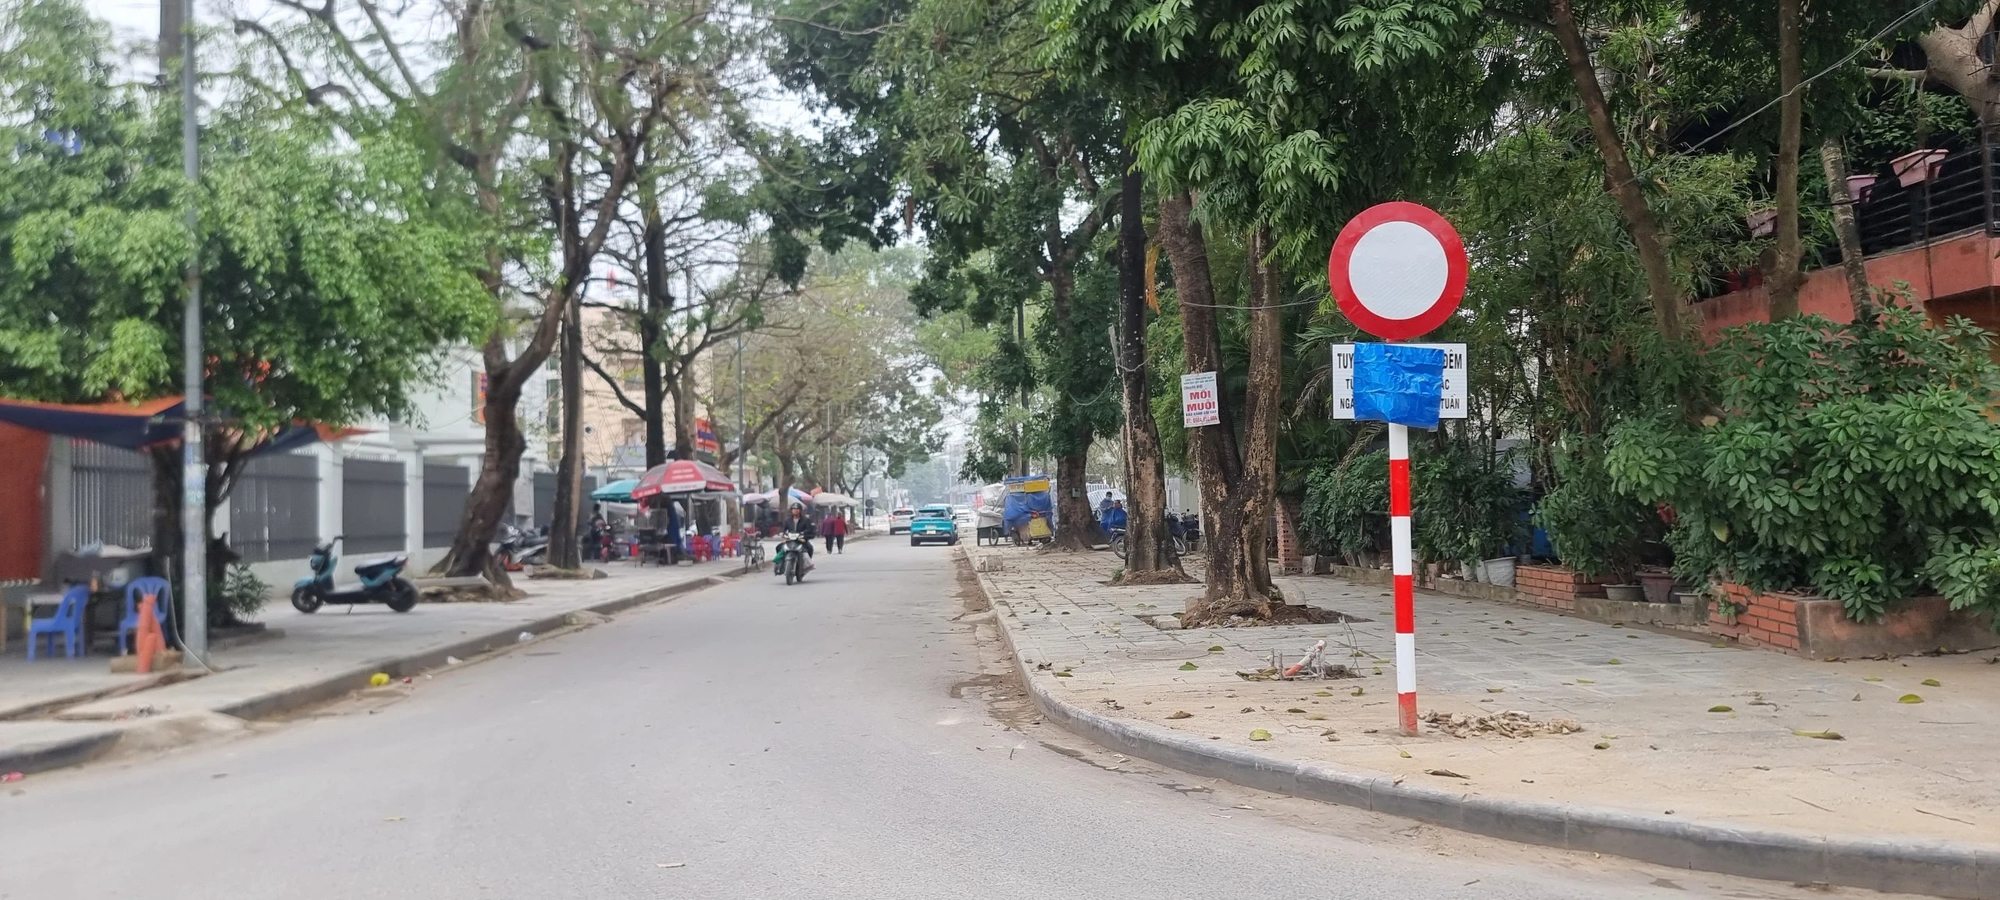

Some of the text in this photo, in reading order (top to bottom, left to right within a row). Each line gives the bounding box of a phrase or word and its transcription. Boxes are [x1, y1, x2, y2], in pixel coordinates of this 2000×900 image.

[1337, 353, 1354, 369] TUY
[1189, 388, 1211, 400] MỐI
[1440, 393, 1460, 410] TUẦN
